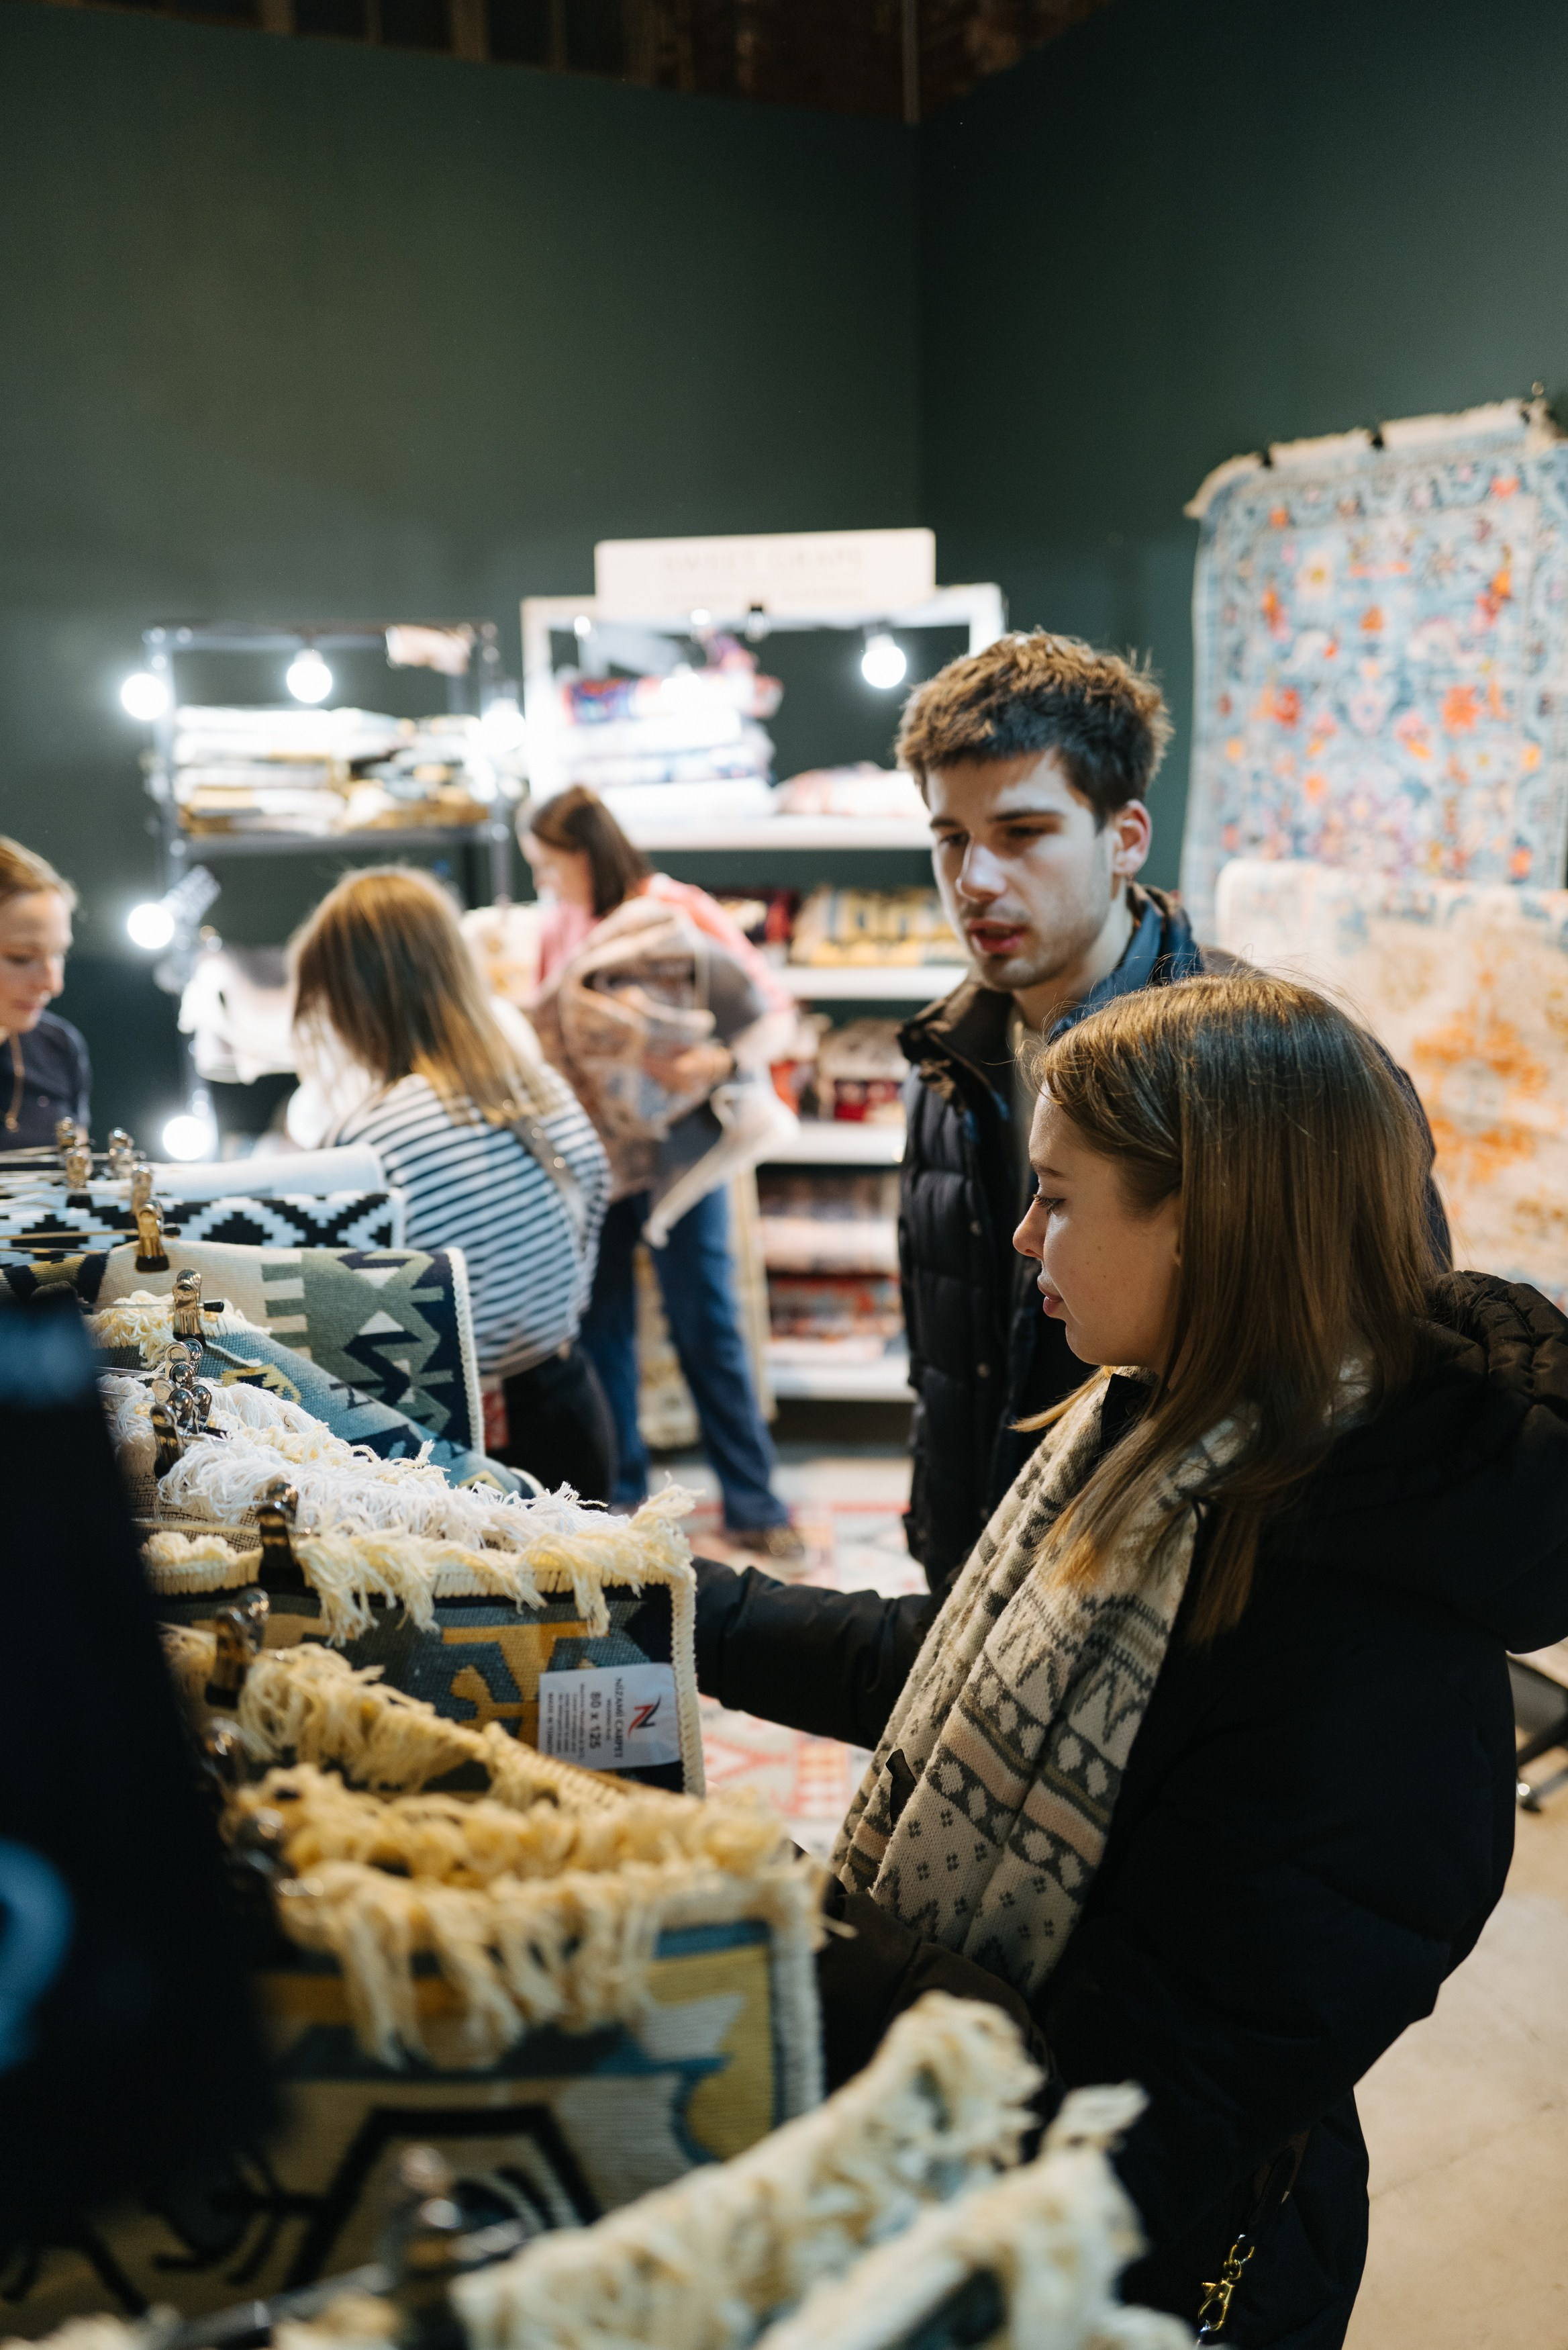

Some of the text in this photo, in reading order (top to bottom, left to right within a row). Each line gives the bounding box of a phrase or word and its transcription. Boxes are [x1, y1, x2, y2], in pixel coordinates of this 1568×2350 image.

[590, 1691, 601, 1708] 80
[589, 1726, 601, 1749] 125
[614, 1720, 624, 1758] CARPET
